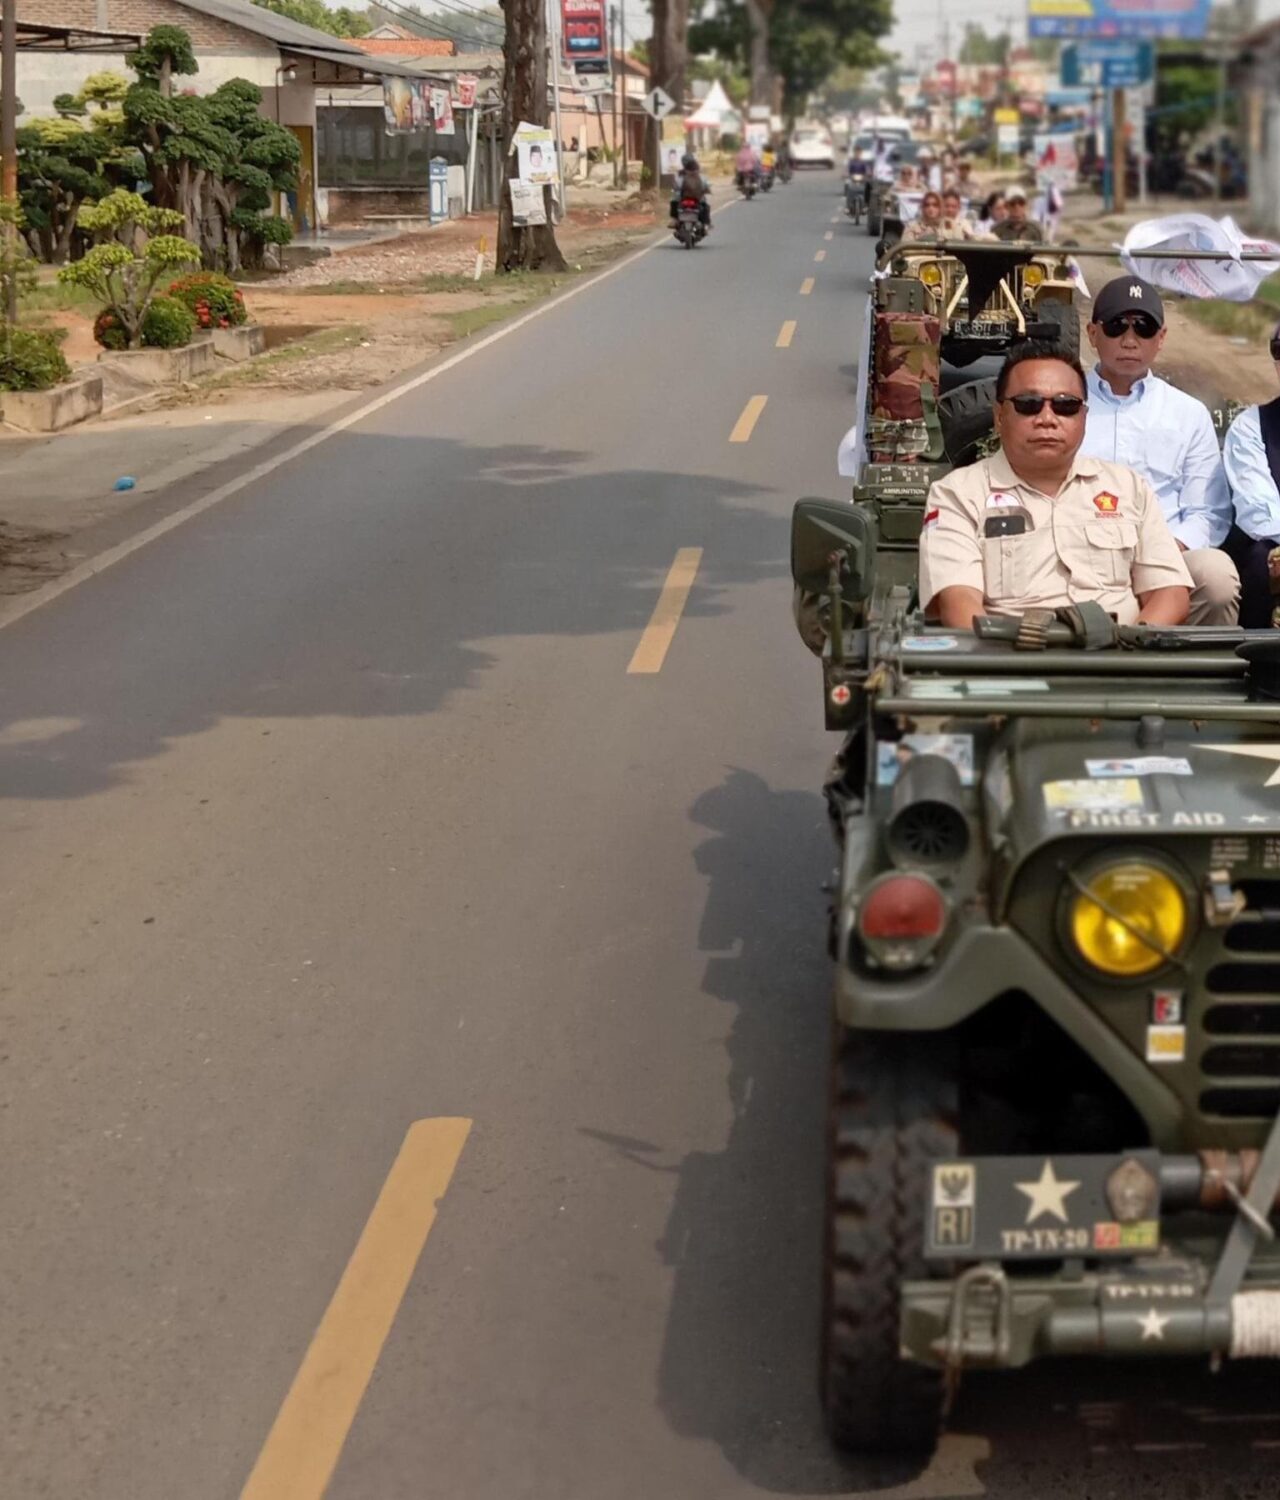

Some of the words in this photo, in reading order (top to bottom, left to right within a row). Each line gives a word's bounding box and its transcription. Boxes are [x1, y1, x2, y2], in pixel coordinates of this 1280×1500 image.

[1071, 810, 1159, 827] FIRST
[1172, 811, 1226, 826] AID
[937, 1208, 969, 1243] RI
